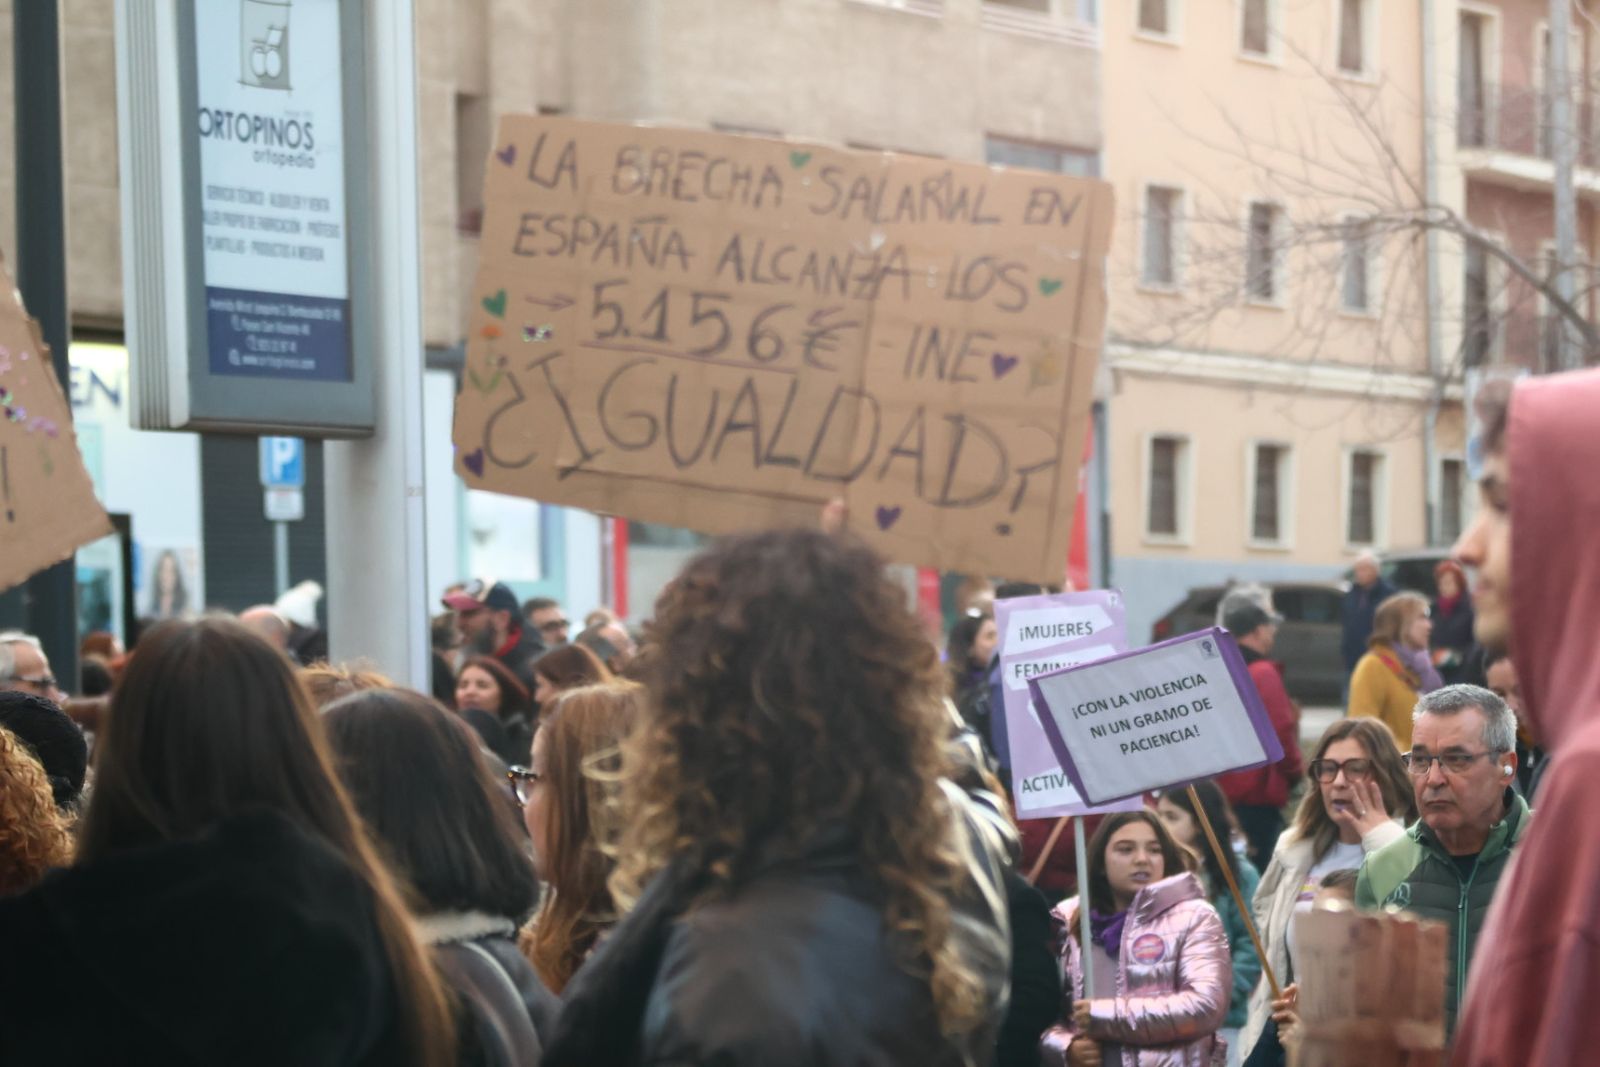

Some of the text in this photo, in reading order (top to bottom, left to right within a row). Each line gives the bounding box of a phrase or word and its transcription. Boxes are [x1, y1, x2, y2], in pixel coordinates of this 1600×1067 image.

[198, 107, 314, 150] ORTOPINOS
[252, 149, 316, 170] ortopedia
[528, 132, 578, 191] LA
[611, 145, 783, 208] BRECHA
[1023, 187, 1083, 226] EN
[512, 211, 1030, 313] ESPAÑA ALCANZA LOS
[272, 437, 297, 482] P
[483, 348, 1060, 537] ¿IGUALDAD?
[1018, 621, 1093, 642] ¡MUJERES
[1071, 673, 1208, 720] ¡CON LA VIOLENCIA
[1089, 698, 1213, 740] NI UN GRAMO DE
[1119, 724, 1201, 756] PACIENCIA!
